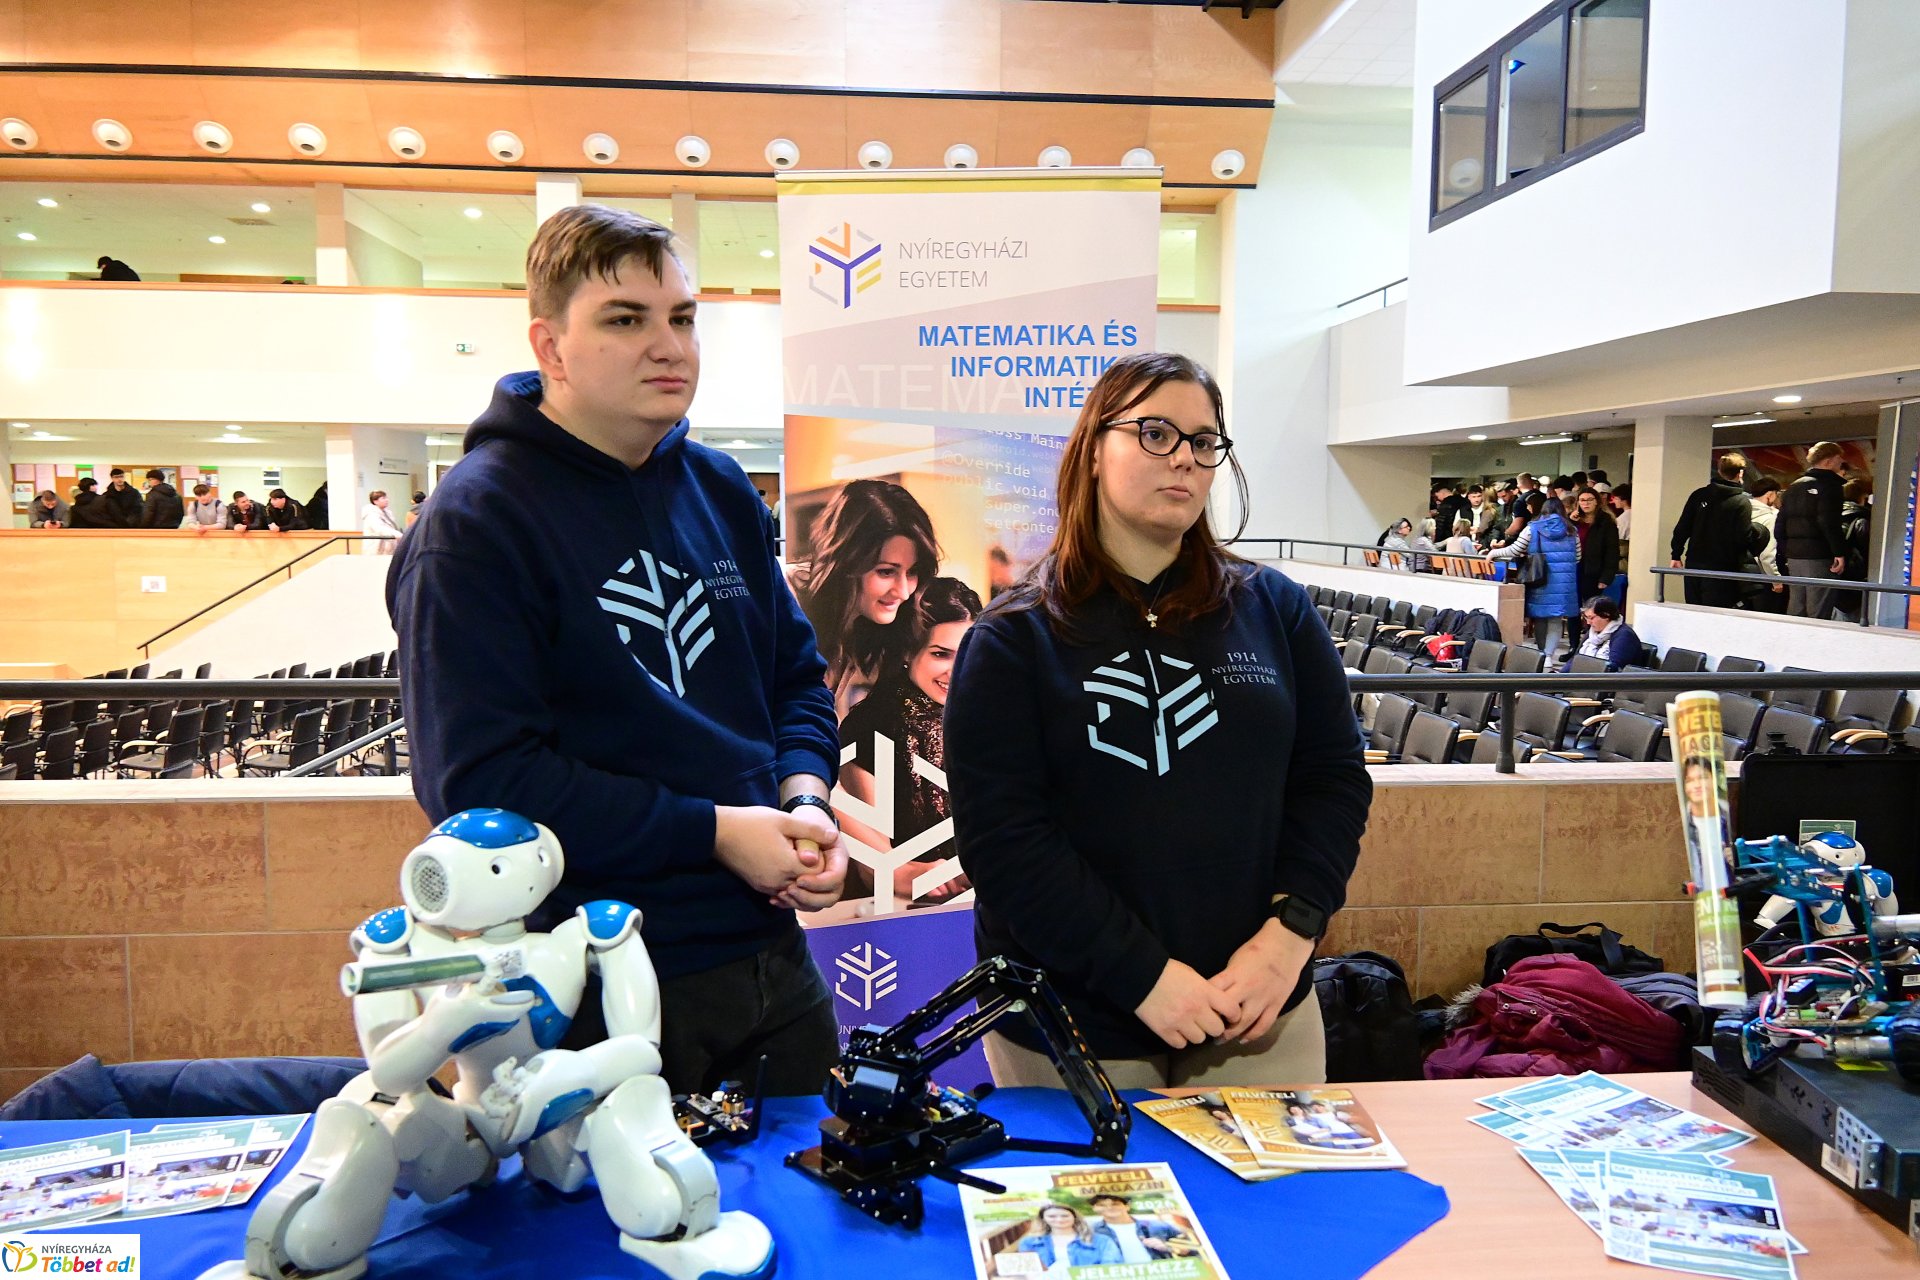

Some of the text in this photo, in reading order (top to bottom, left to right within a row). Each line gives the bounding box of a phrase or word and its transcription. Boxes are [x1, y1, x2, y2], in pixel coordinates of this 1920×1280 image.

[899, 236, 1029, 260] NYÍREGYHÁZI
[899, 270, 988, 289] EGYETEM
[918, 319, 1138, 347] MATEMATIKA ÉS
[951, 355, 1117, 378] INFORMATIK
[1024, 381, 1092, 408] INTÉ
[942, 451, 1031, 478] @Override
[1012, 484, 1047, 499] void
[1226, 651, 1258, 663] 1914
[1222, 673, 1276, 685] EGYETEM
[1057, 1169, 1147, 1187] FELVÉTELI
[1080, 1180, 1165, 1196] MAGAZIN
[1076, 1259, 1197, 1280] JELENTKEZZ
